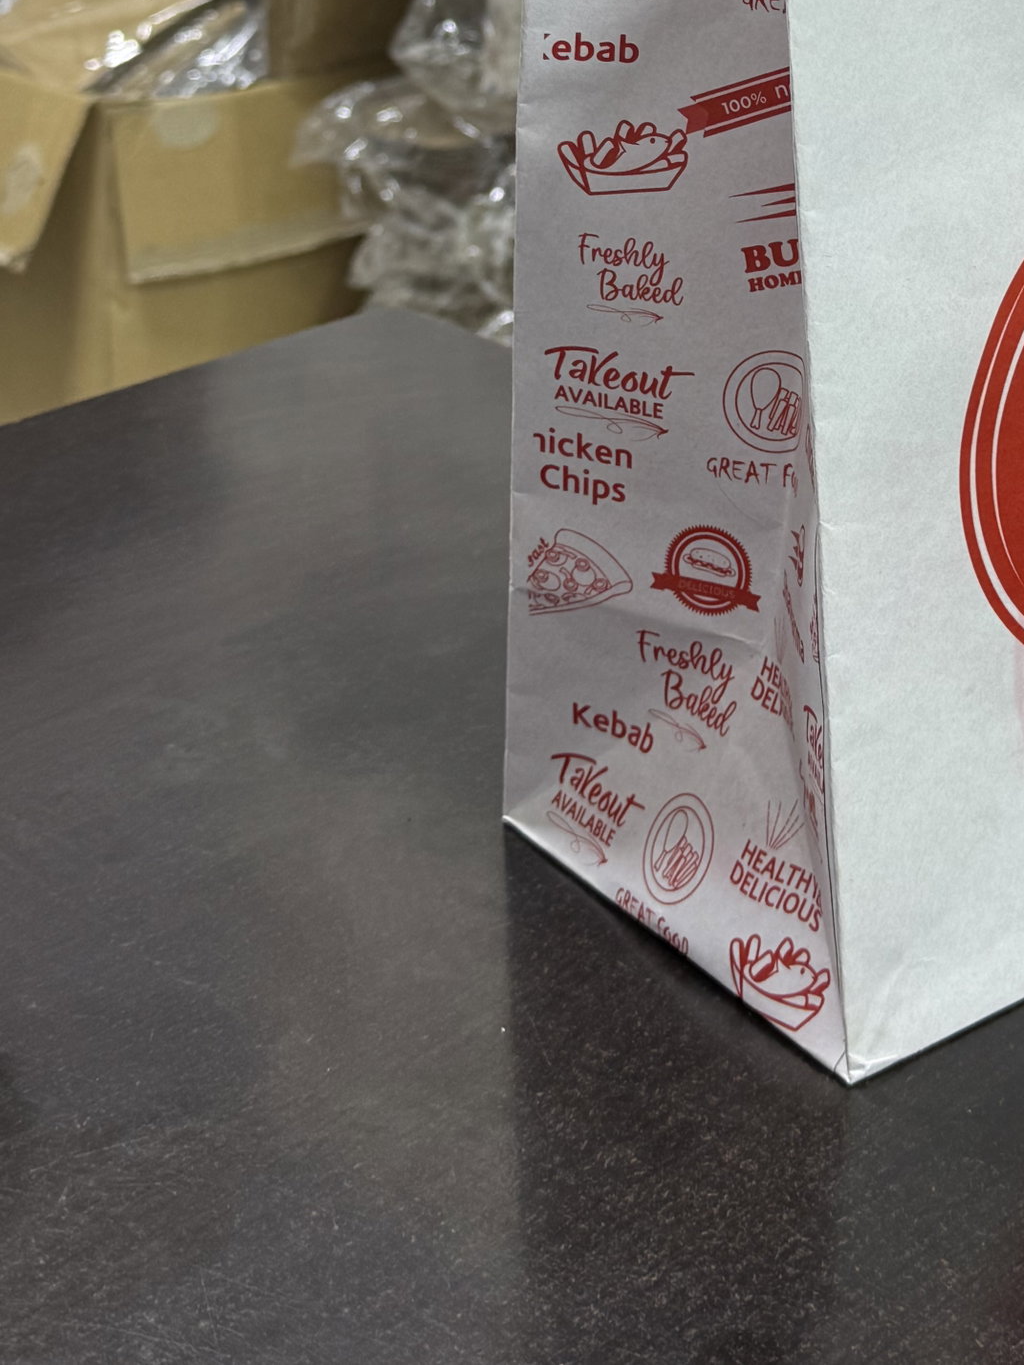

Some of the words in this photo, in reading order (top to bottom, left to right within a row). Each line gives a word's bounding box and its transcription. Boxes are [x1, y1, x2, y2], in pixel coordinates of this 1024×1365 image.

[542, 32, 640, 64] ebab
[721, 91, 767, 115] 100%
[578, 232, 669, 286] Freshly
[596, 268, 684, 307] Baked
[544, 346, 695, 401] Takeout
[554, 384, 664, 420] AVAILABLE
[540, 463, 626, 506] Chips
[706, 456, 777, 485] GREAT
[678, 579, 736, 599] DELICIOUS
[636, 629, 735, 704] Freshly
[572, 702, 654, 754] Kebab
[661, 669, 738, 738] Baked
[551, 752, 645, 828] Takeout
[552, 790, 616, 847] AVAILABLE
[729, 859, 823, 932] DELICIOUS
